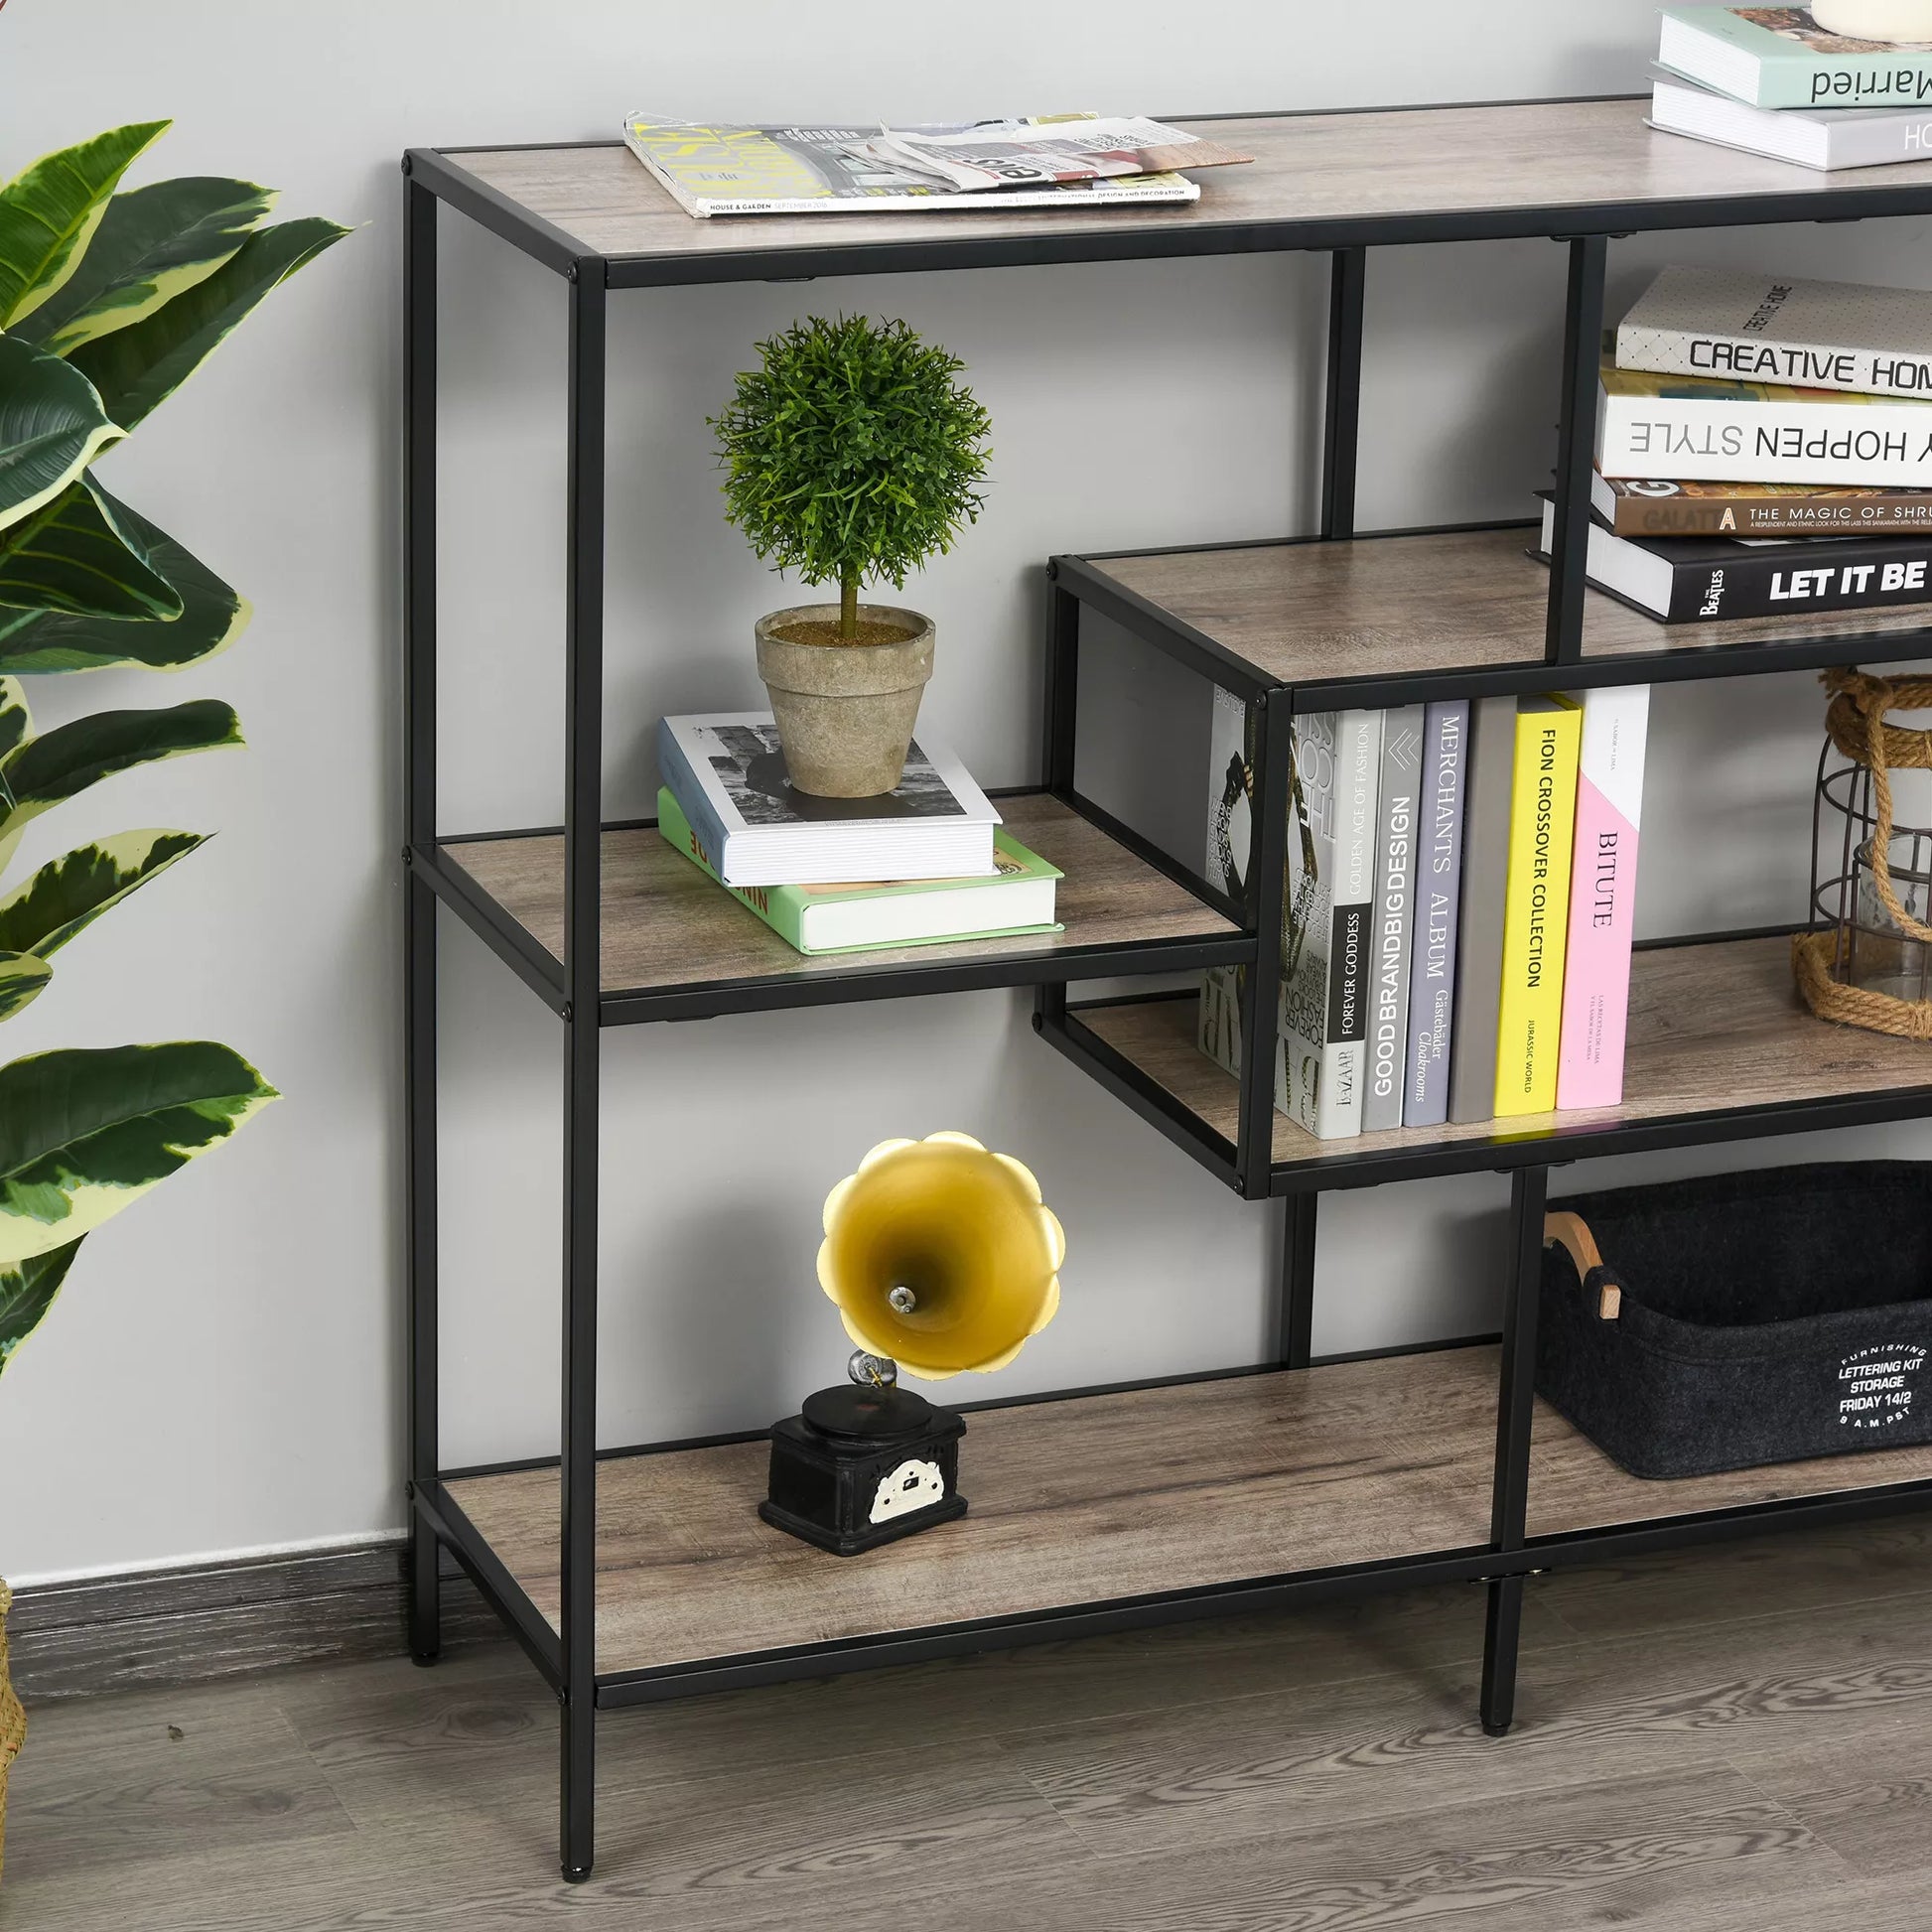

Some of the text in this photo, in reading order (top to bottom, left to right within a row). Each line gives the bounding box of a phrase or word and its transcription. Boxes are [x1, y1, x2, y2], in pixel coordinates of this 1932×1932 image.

[1689, 340, 1856, 383] CREATIVE
[1629, 422, 1743, 457] STYLE
[1755, 427, 1907, 463] HOPPEN
[1749, 506, 1932, 520] THE MAGIC OF SHR
[1769, 560, 1928, 601] LET IT BE
[1349, 723, 1369, 895] GOLDEN AGE OF FASHION
[1426, 715, 1460, 979] MERCHANTS ALBUM
[1527, 729, 1556, 988] FION CROSSOVER COLLECTION
[1592, 832, 1618, 928] BITUTE
[1341, 912, 1360, 1035] FOREVER GODDESS
[1432, 989, 1449, 1059] Gästebäder
[1416, 1032, 1432, 1102] Cloakrooms
[1524, 1019, 1535, 1094] JURASSIC WORLD
[1838, 1357, 1924, 1380] LETTERING KIT
[1841, 1343, 1927, 1366] FURNISHING
[1839, 1391, 1912, 1414] FRIDAY 14/2
[1850, 1375, 1905, 1394] STORAGE
